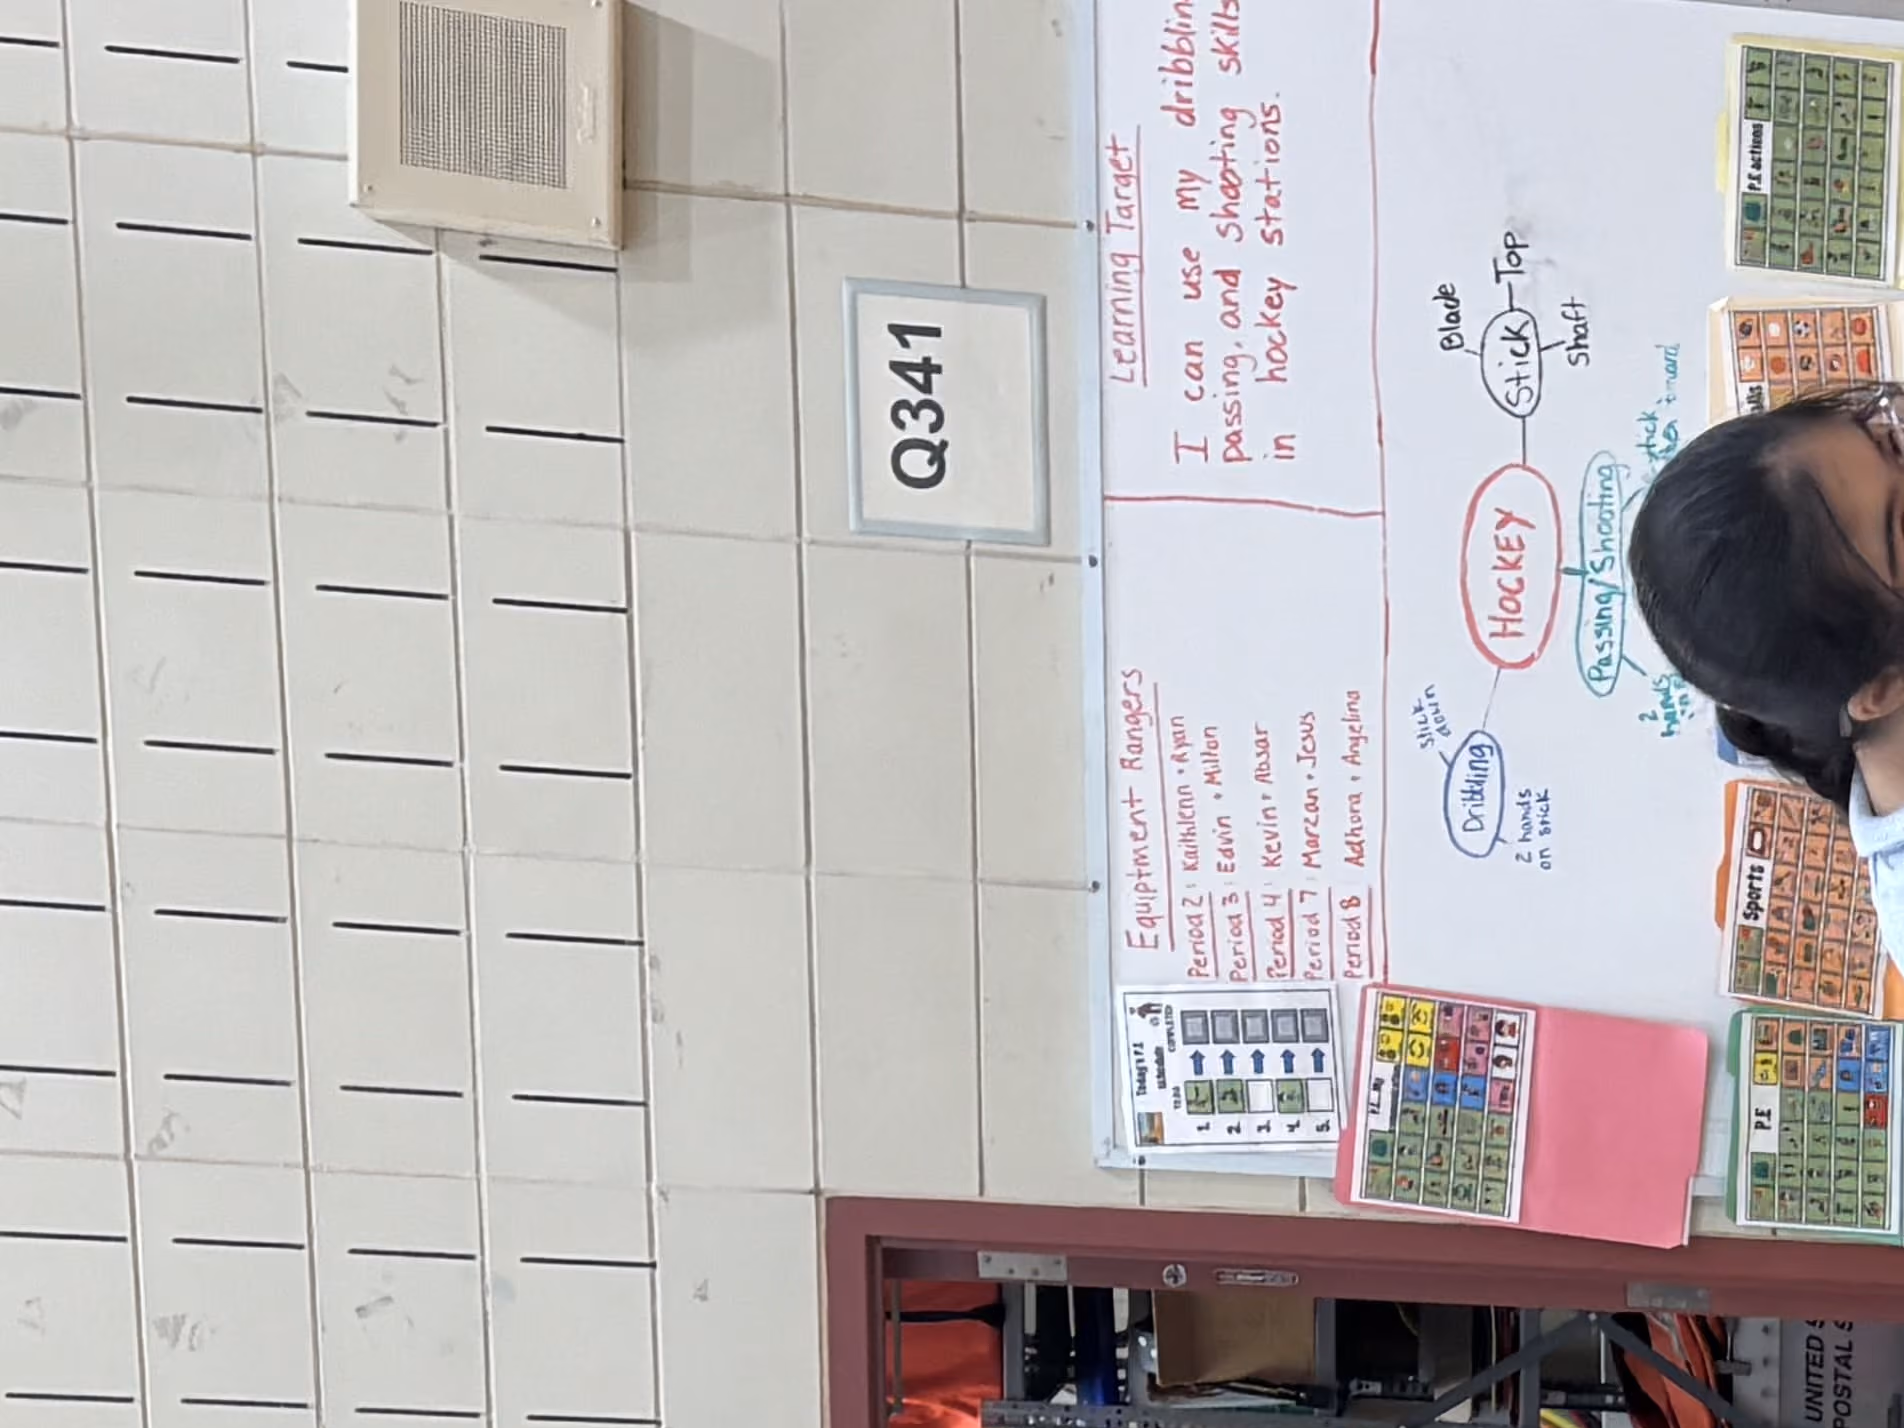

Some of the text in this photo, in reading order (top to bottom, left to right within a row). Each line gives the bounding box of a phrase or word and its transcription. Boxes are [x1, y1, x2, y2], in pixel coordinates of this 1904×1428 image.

[1176, 168, 1211, 210] my
[1103, 133, 1142, 385] Learning Target
[1210, 0, 1255, 464] passing, and shooting skills
[1493, 231, 1528, 284] Top
[1182, 246, 1202, 301] use
[1254, 277, 1298, 383] hockey
[1432, 283, 1464, 351] Blade
[1186, 341, 1205, 402] can
[1498, 319, 1533, 408] Stick
[887, 321, 948, 490] Q341
[1174, 431, 1208, 464] I
[1263, 434, 1297, 461] in
[1169, 715, 1191, 763] Ryan
[1296, 711, 1316, 768] Jesus
[1341, 688, 1368, 767] Angelina
[1118, 667, 1164, 950] Equiptment Rangers
[1255, 805, 1283, 868] Kevin
[1516, 788, 1533, 864] 2 hands
[1536, 788, 1552, 871] on stick
[1214, 816, 1236, 873] Edvin
[1742, 865, 1766, 921] Sports
[1184, 913, 1210, 978] Period
[1230, 913, 1249, 983] Period
[1265, 916, 1288, 978] Period
[1297, 911, 1323, 981] Period
[1342, 915, 1363, 979] Period
[1804, 1334, 1824, 1422] UNITED
